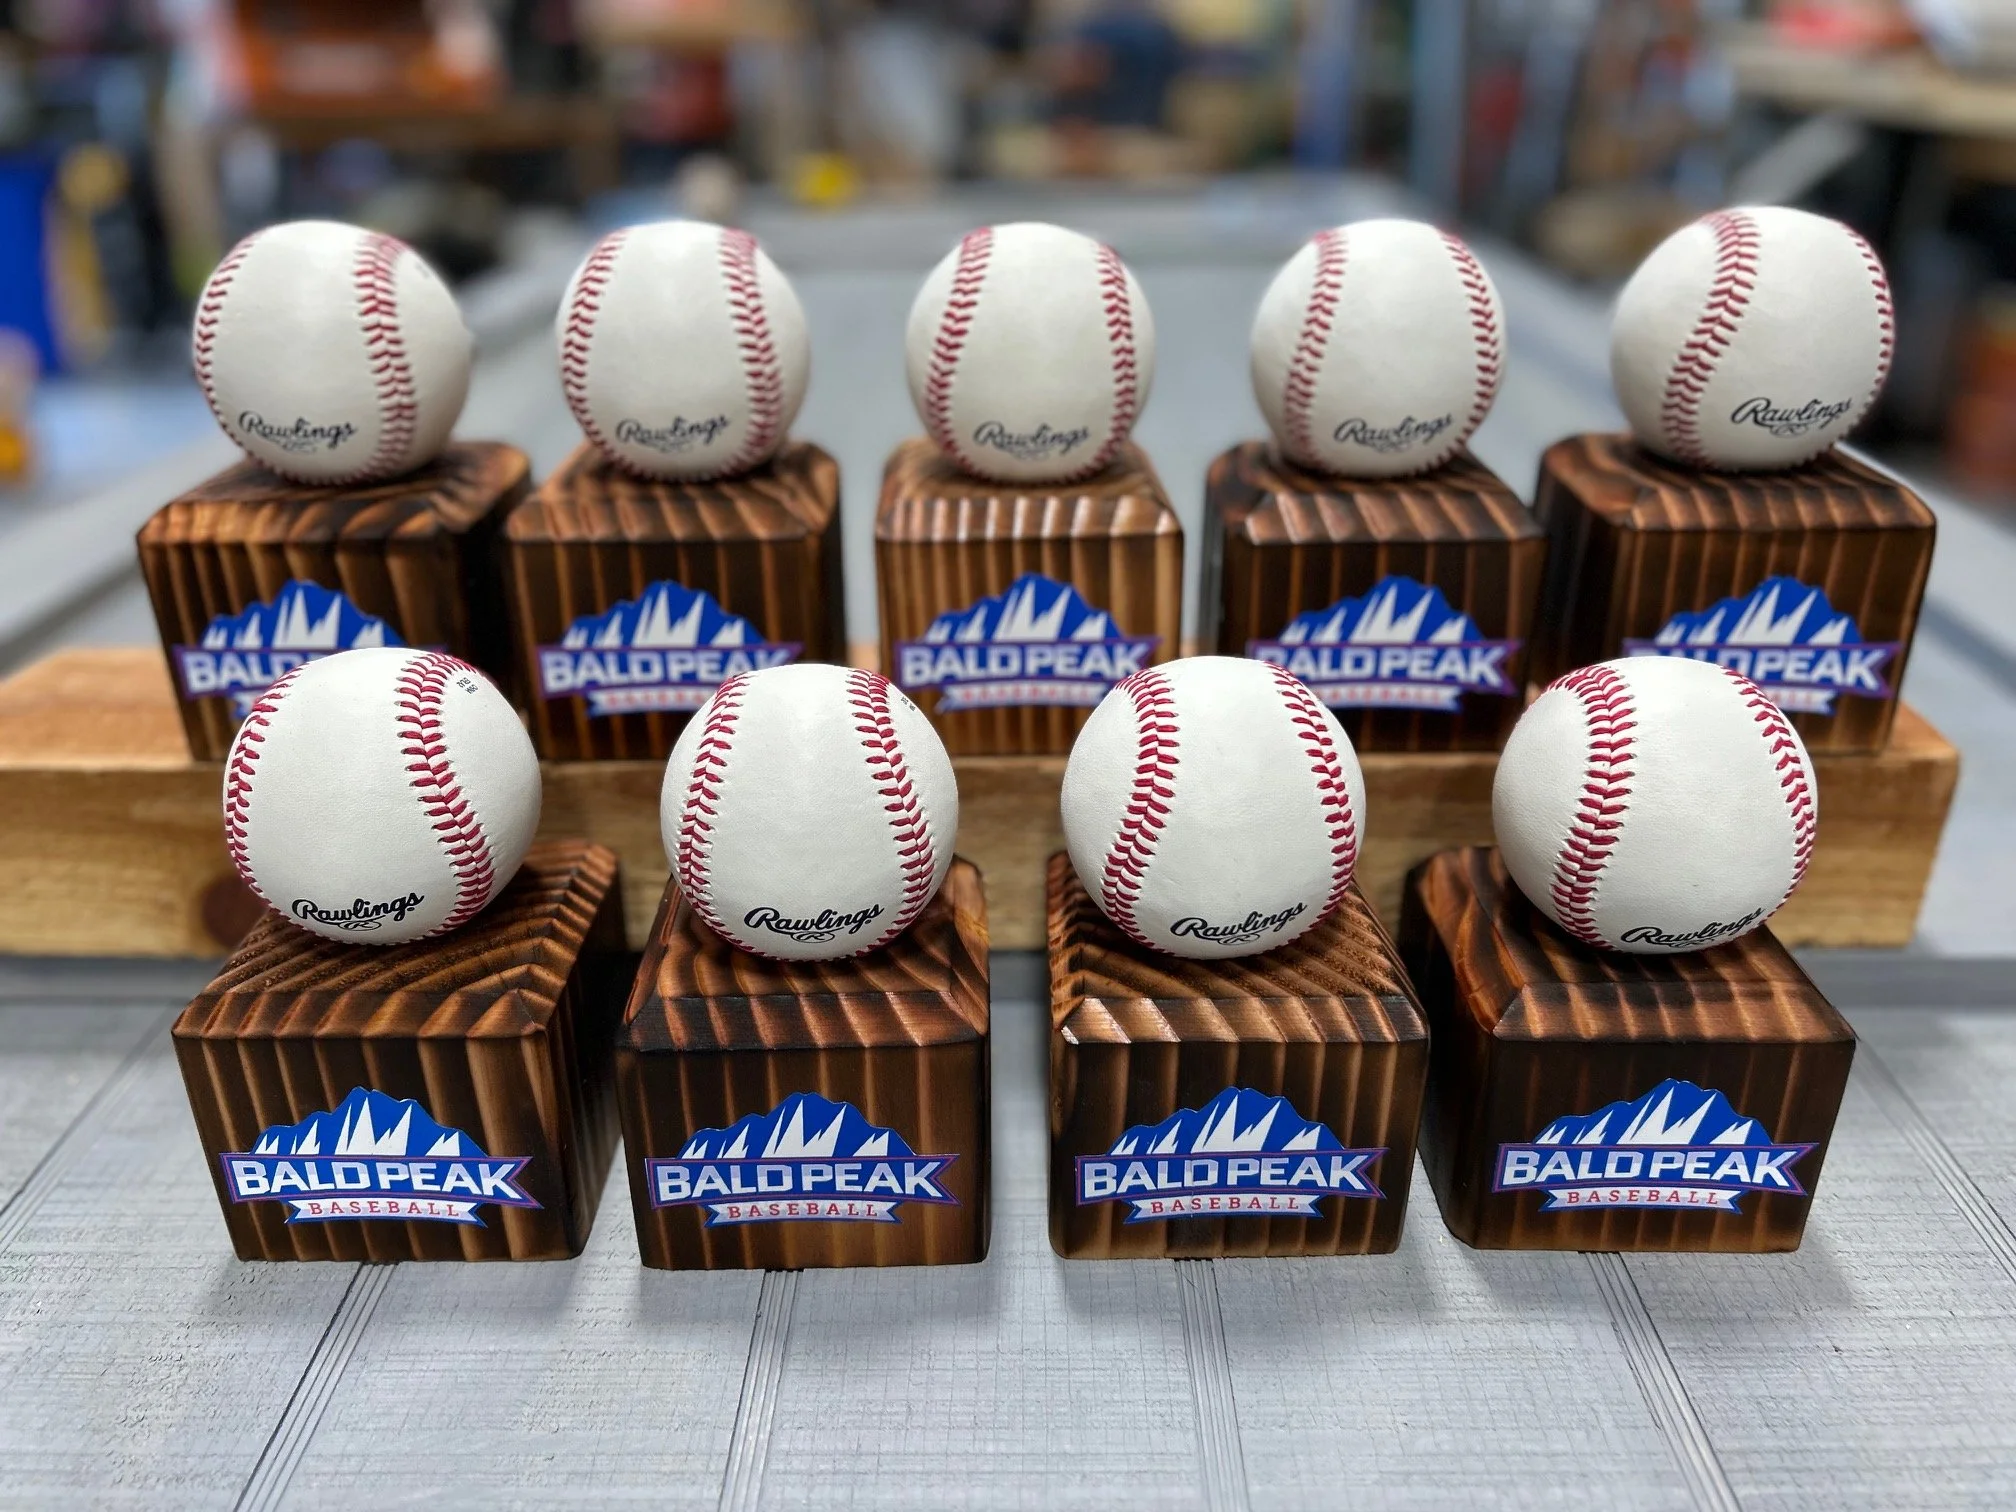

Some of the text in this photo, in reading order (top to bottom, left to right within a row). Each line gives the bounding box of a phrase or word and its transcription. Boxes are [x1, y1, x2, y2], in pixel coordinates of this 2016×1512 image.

[239, 411, 358, 449] Rawlings
[616, 415, 730, 447] Rawlings
[1333, 415, 1452, 447] Rawlings
[1731, 397, 1852, 430] Rawlings
[973, 421, 1090, 455] Rawlings
[540, 651, 657, 692] BALD
[902, 643, 1150, 687] BALD PEAK
[1379, 646, 1507, 687] PEAK
[1755, 649, 1886, 691] PEAK
[292, 892, 425, 925] Rawlings
[744, 904, 885, 935] Rawlings
[1170, 902, 1308, 940] Rawlings
[1621, 907, 1766, 946] Rawlings
[231, 1160, 523, 1200] BALD PEAK
[656, 1162, 943, 1202] BALD PEAK
[1084, 1155, 1369, 1198] BALD PEAK
[1502, 1150, 1798, 1187] BALD PEAK
[308, 1200, 459, 1217] BASEBALL
[727, 1203, 878, 1219] BASEBALL
[1151, 1197, 1299, 1214] BASEBALL
[1566, 1190, 1719, 1205] BASEBALL
